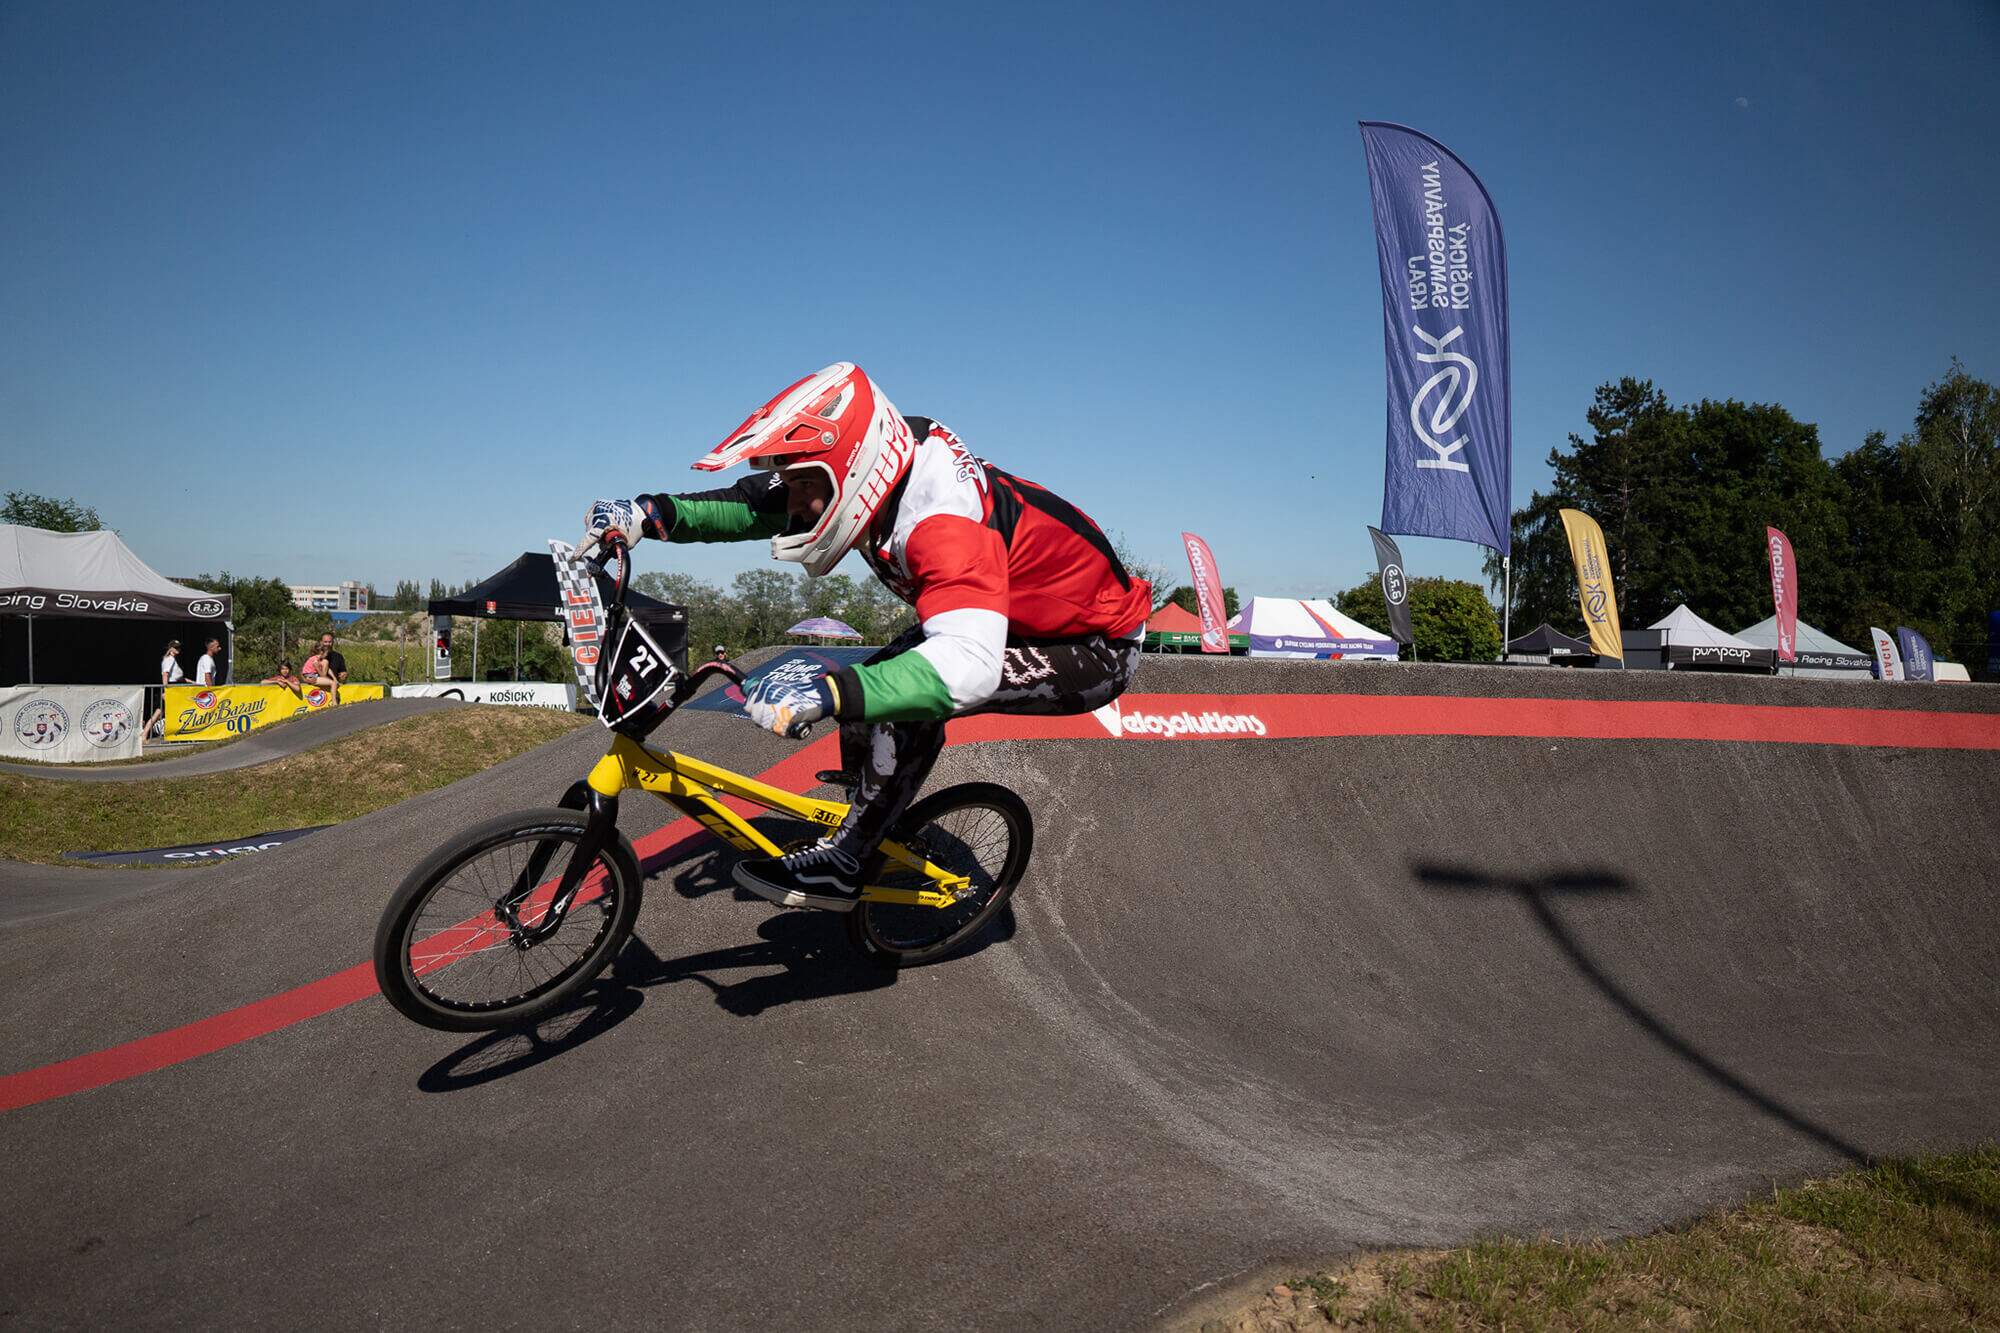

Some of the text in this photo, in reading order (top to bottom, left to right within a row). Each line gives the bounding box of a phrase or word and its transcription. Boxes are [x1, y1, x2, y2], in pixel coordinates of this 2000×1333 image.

[55, 593, 149, 612] Slovakia
[628, 645, 658, 679] 27
[1692, 647, 1751, 663] pumpcup
[1801, 655, 1833, 666] Racing
[1835, 657, 1872, 666] Slovakia
[762, 671, 819, 681] TRACK
[773, 664, 822, 673] PUMP
[490, 689, 535, 702] KOŠICKÝ
[1092, 699, 1266, 738] Velosolutions
[812, 808, 841, 825] F-118
